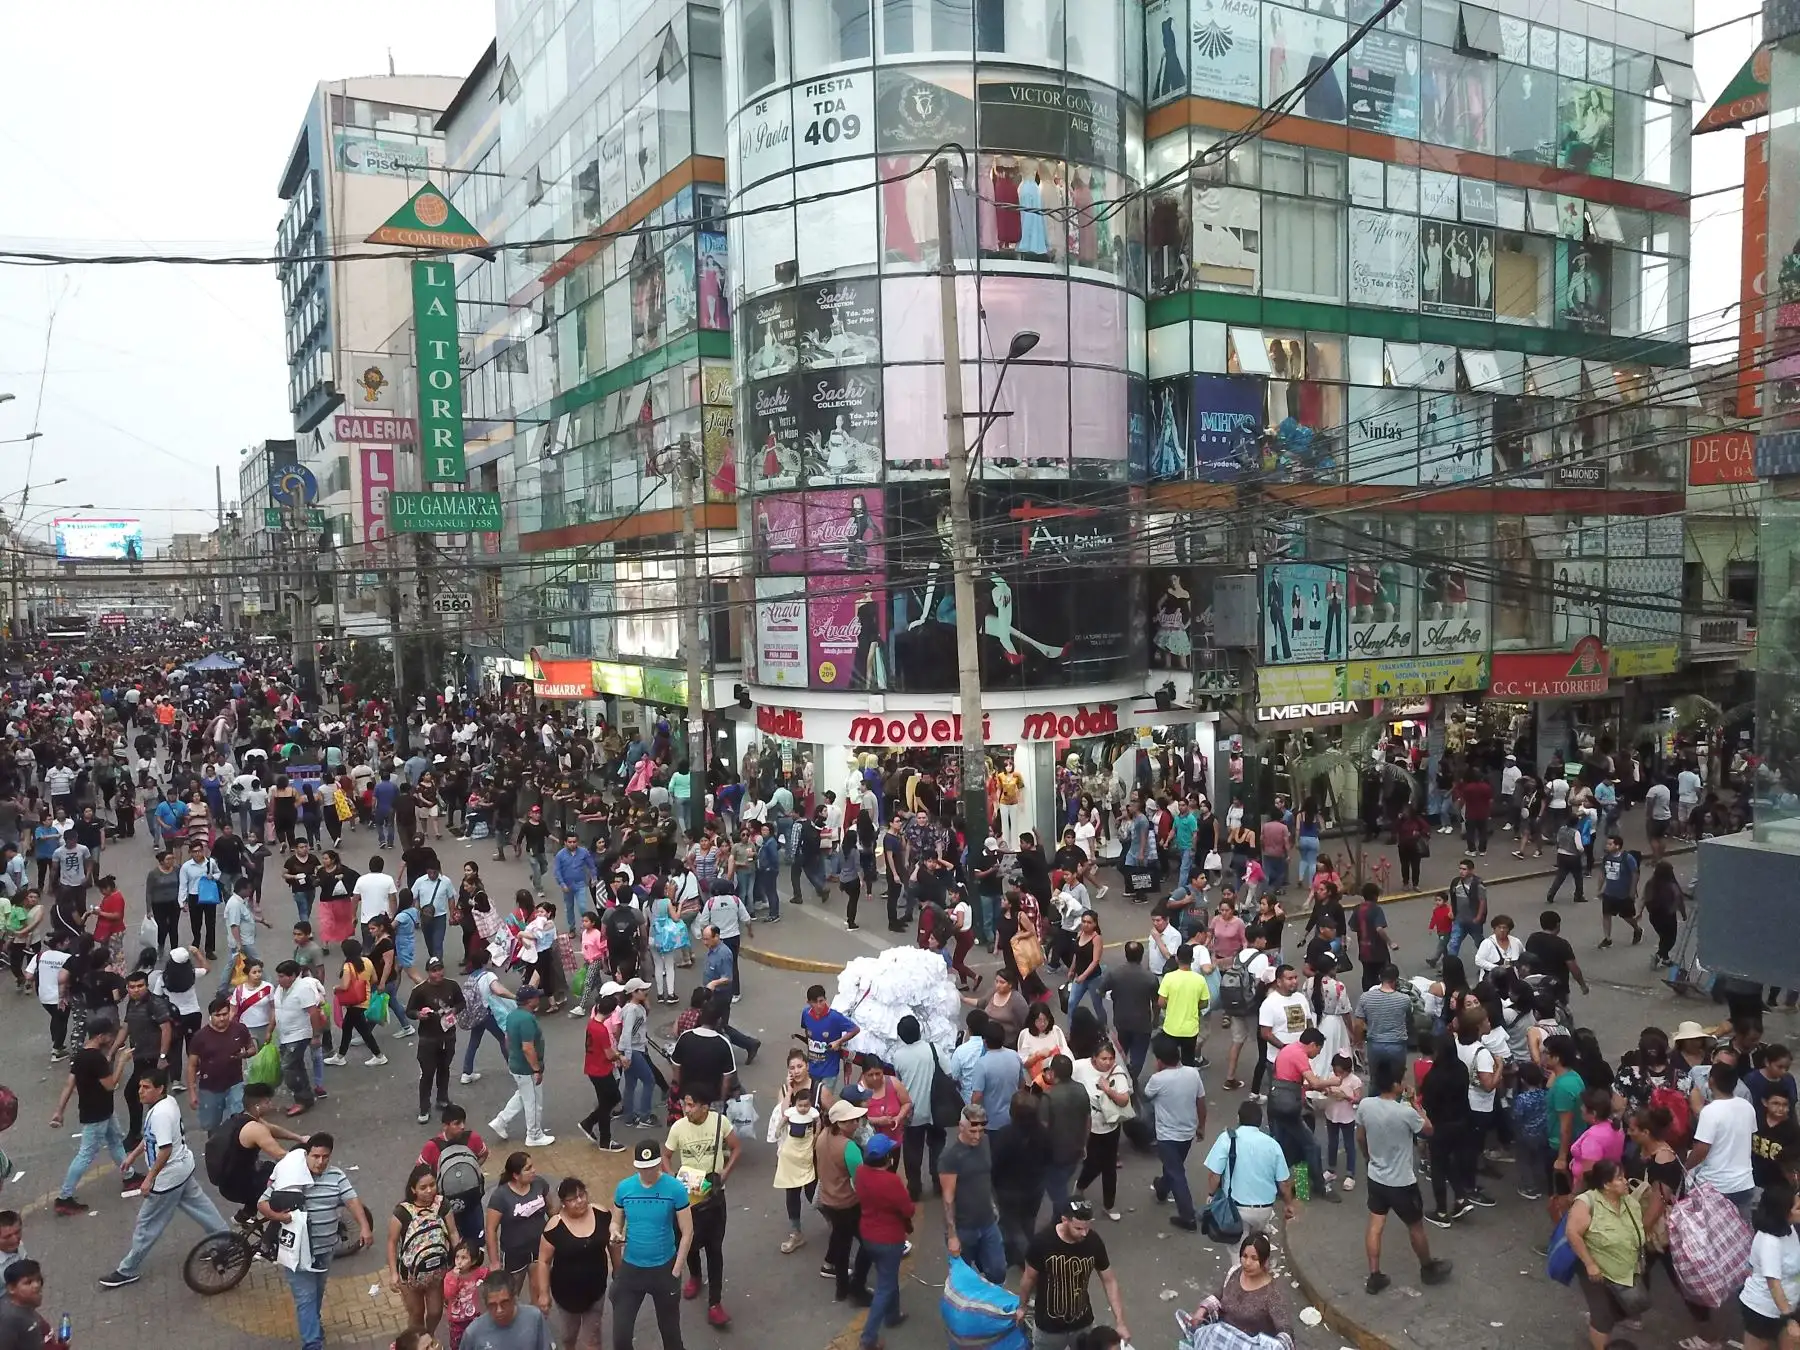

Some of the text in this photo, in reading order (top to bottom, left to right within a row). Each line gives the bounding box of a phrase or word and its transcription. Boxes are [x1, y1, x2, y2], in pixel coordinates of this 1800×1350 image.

[755, 78, 854, 116] DE FIESTA
[1009, 86, 1062, 107] VICTOR
[813, 98, 846, 116] TDA
[803, 114, 861, 146] 409
[1071, 116, 1089, 132] Alta
[380, 229, 395, 241] C.
[816, 285, 857, 305] Sachi
[755, 385, 790, 411] Sachi
[812, 378, 867, 403] Sachi
[758, 405, 788, 417] COLLECTION
[817, 399, 863, 409] COLLECTION
[337, 418, 415, 441] GALERIA
[1358, 420, 1402, 441] Ninfa's
[1695, 440, 1721, 465] DE
[1560, 466, 1600, 480] DIAMONDS
[395, 495, 499, 516] DE GAMARRA
[418, 518, 467, 529] UNANUE
[470, 518, 493, 529] 1558
[433, 599, 473, 612] 1560
[820, 670, 834, 678] 209
[1493, 681, 1522, 695] C.C.
[1552, 680, 1589, 694] TORRE
[849, 712, 990, 744] modeli
